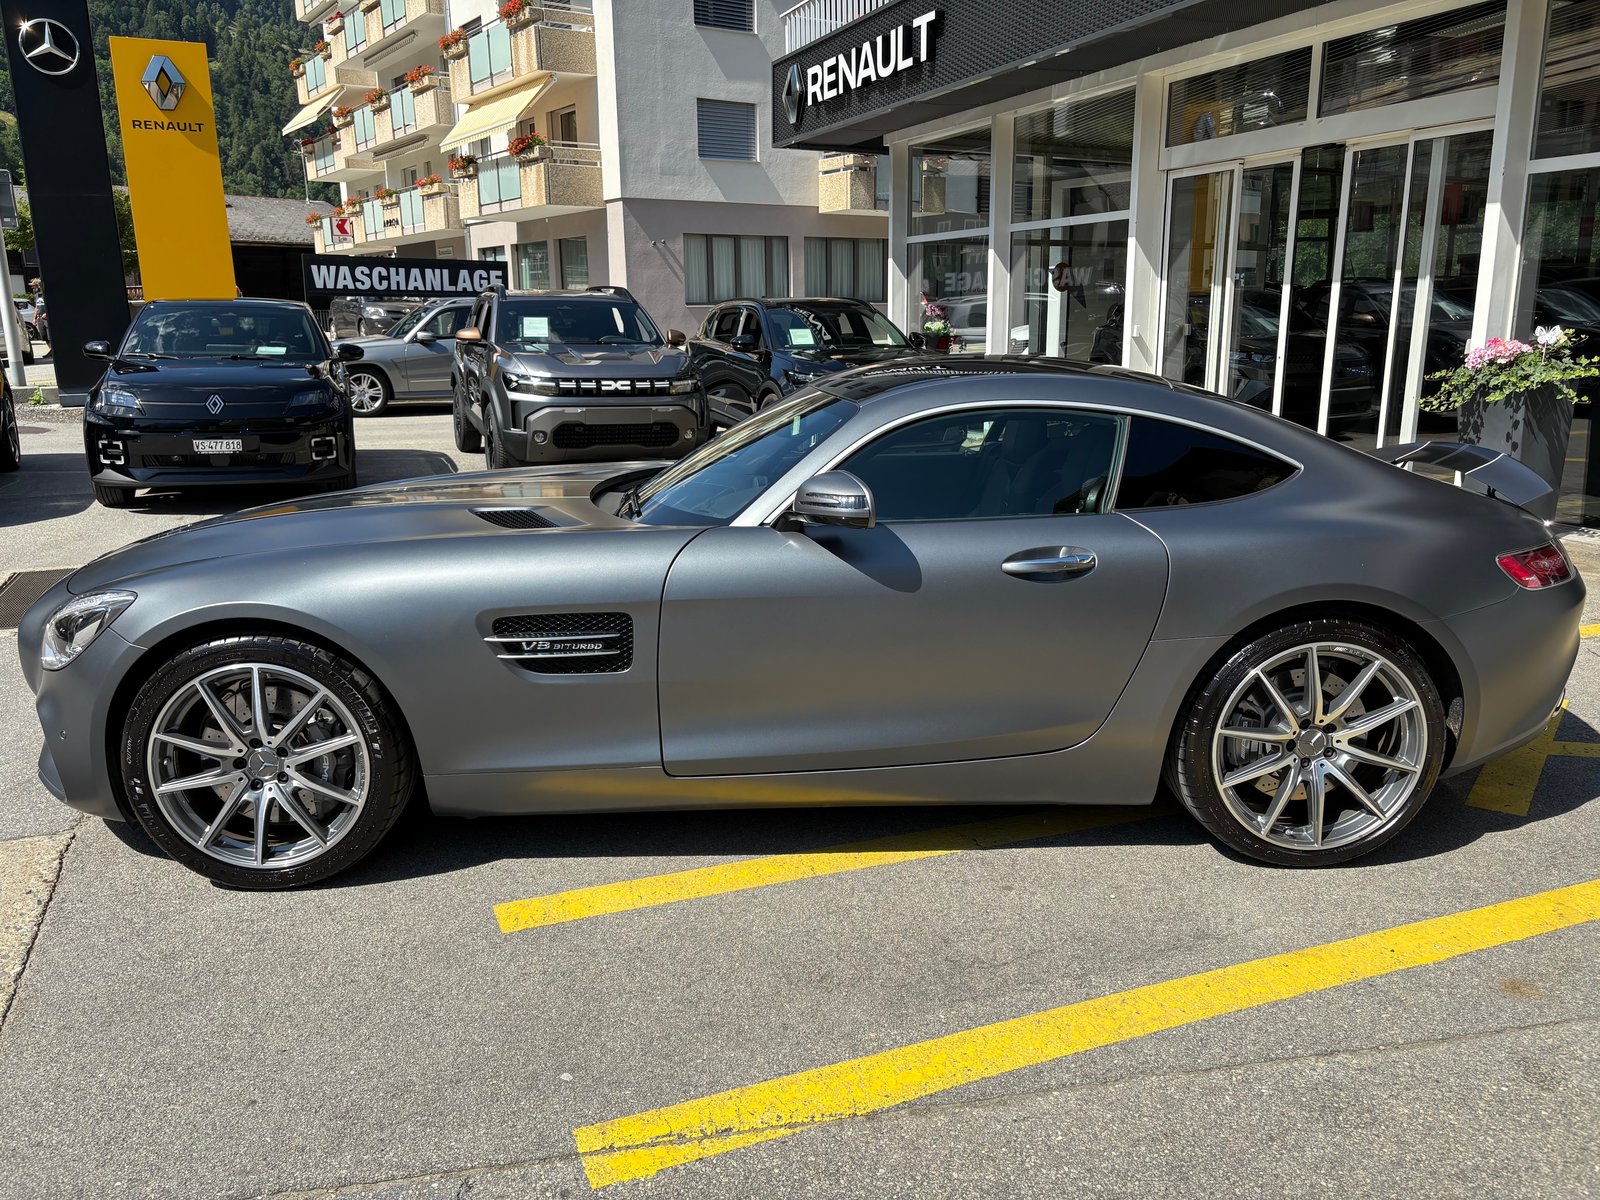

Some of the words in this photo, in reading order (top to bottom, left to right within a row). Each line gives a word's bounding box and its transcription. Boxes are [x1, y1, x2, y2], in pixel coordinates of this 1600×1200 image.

[807, 10, 936, 107] RENAULT
[131, 119, 204, 133] RENAULT
[310, 264, 503, 292] WASCHANLAGE
